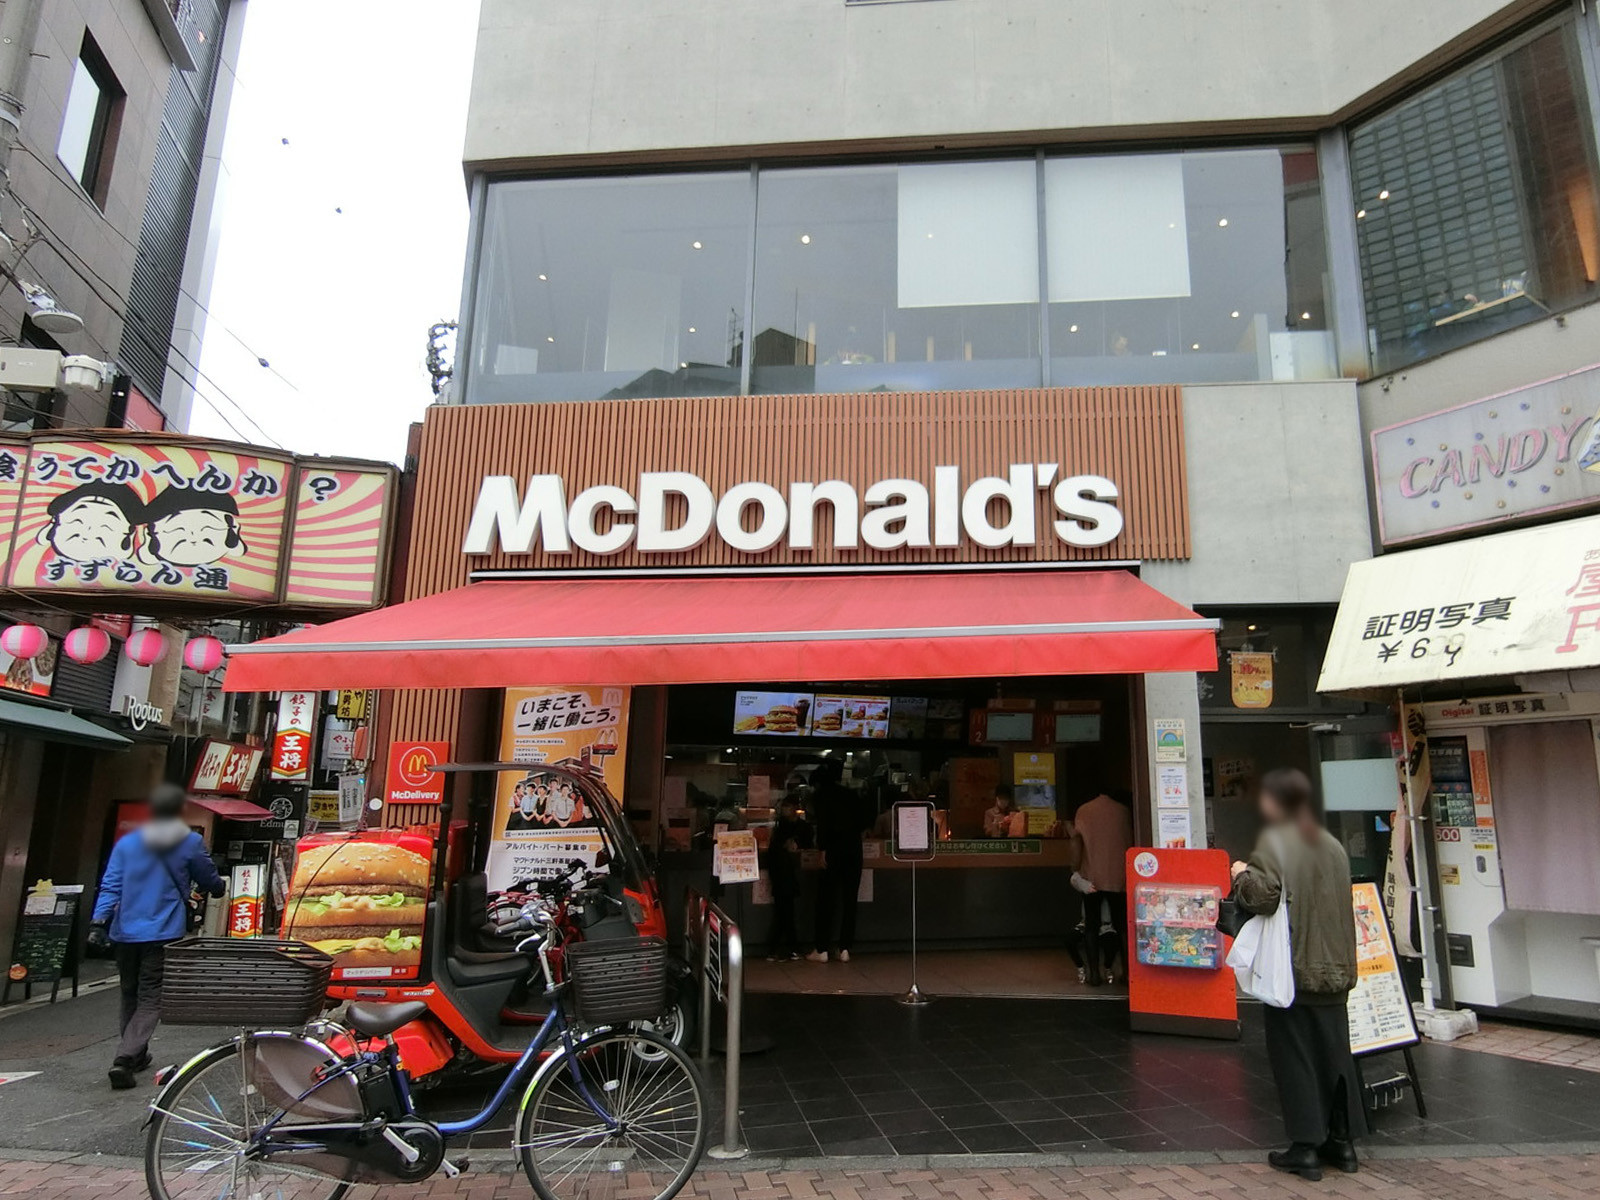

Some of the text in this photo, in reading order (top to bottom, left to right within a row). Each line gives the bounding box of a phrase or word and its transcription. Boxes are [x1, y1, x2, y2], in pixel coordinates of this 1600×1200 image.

[1400, 417, 1592, 498] CANDY
[462, 463, 1124, 556] McDonald's
[48, 559, 228, 590] すずらん通
[1362, 596, 1516, 640] 証明写真
[128, 695, 163, 731] Rootus
[517, 708, 616, 732] 一緒に働こう。
[521, 694, 587, 715] いまこそ、
[1442, 698, 1546, 717] Digital 証明写真
[391, 790, 440, 800] McDelivery
